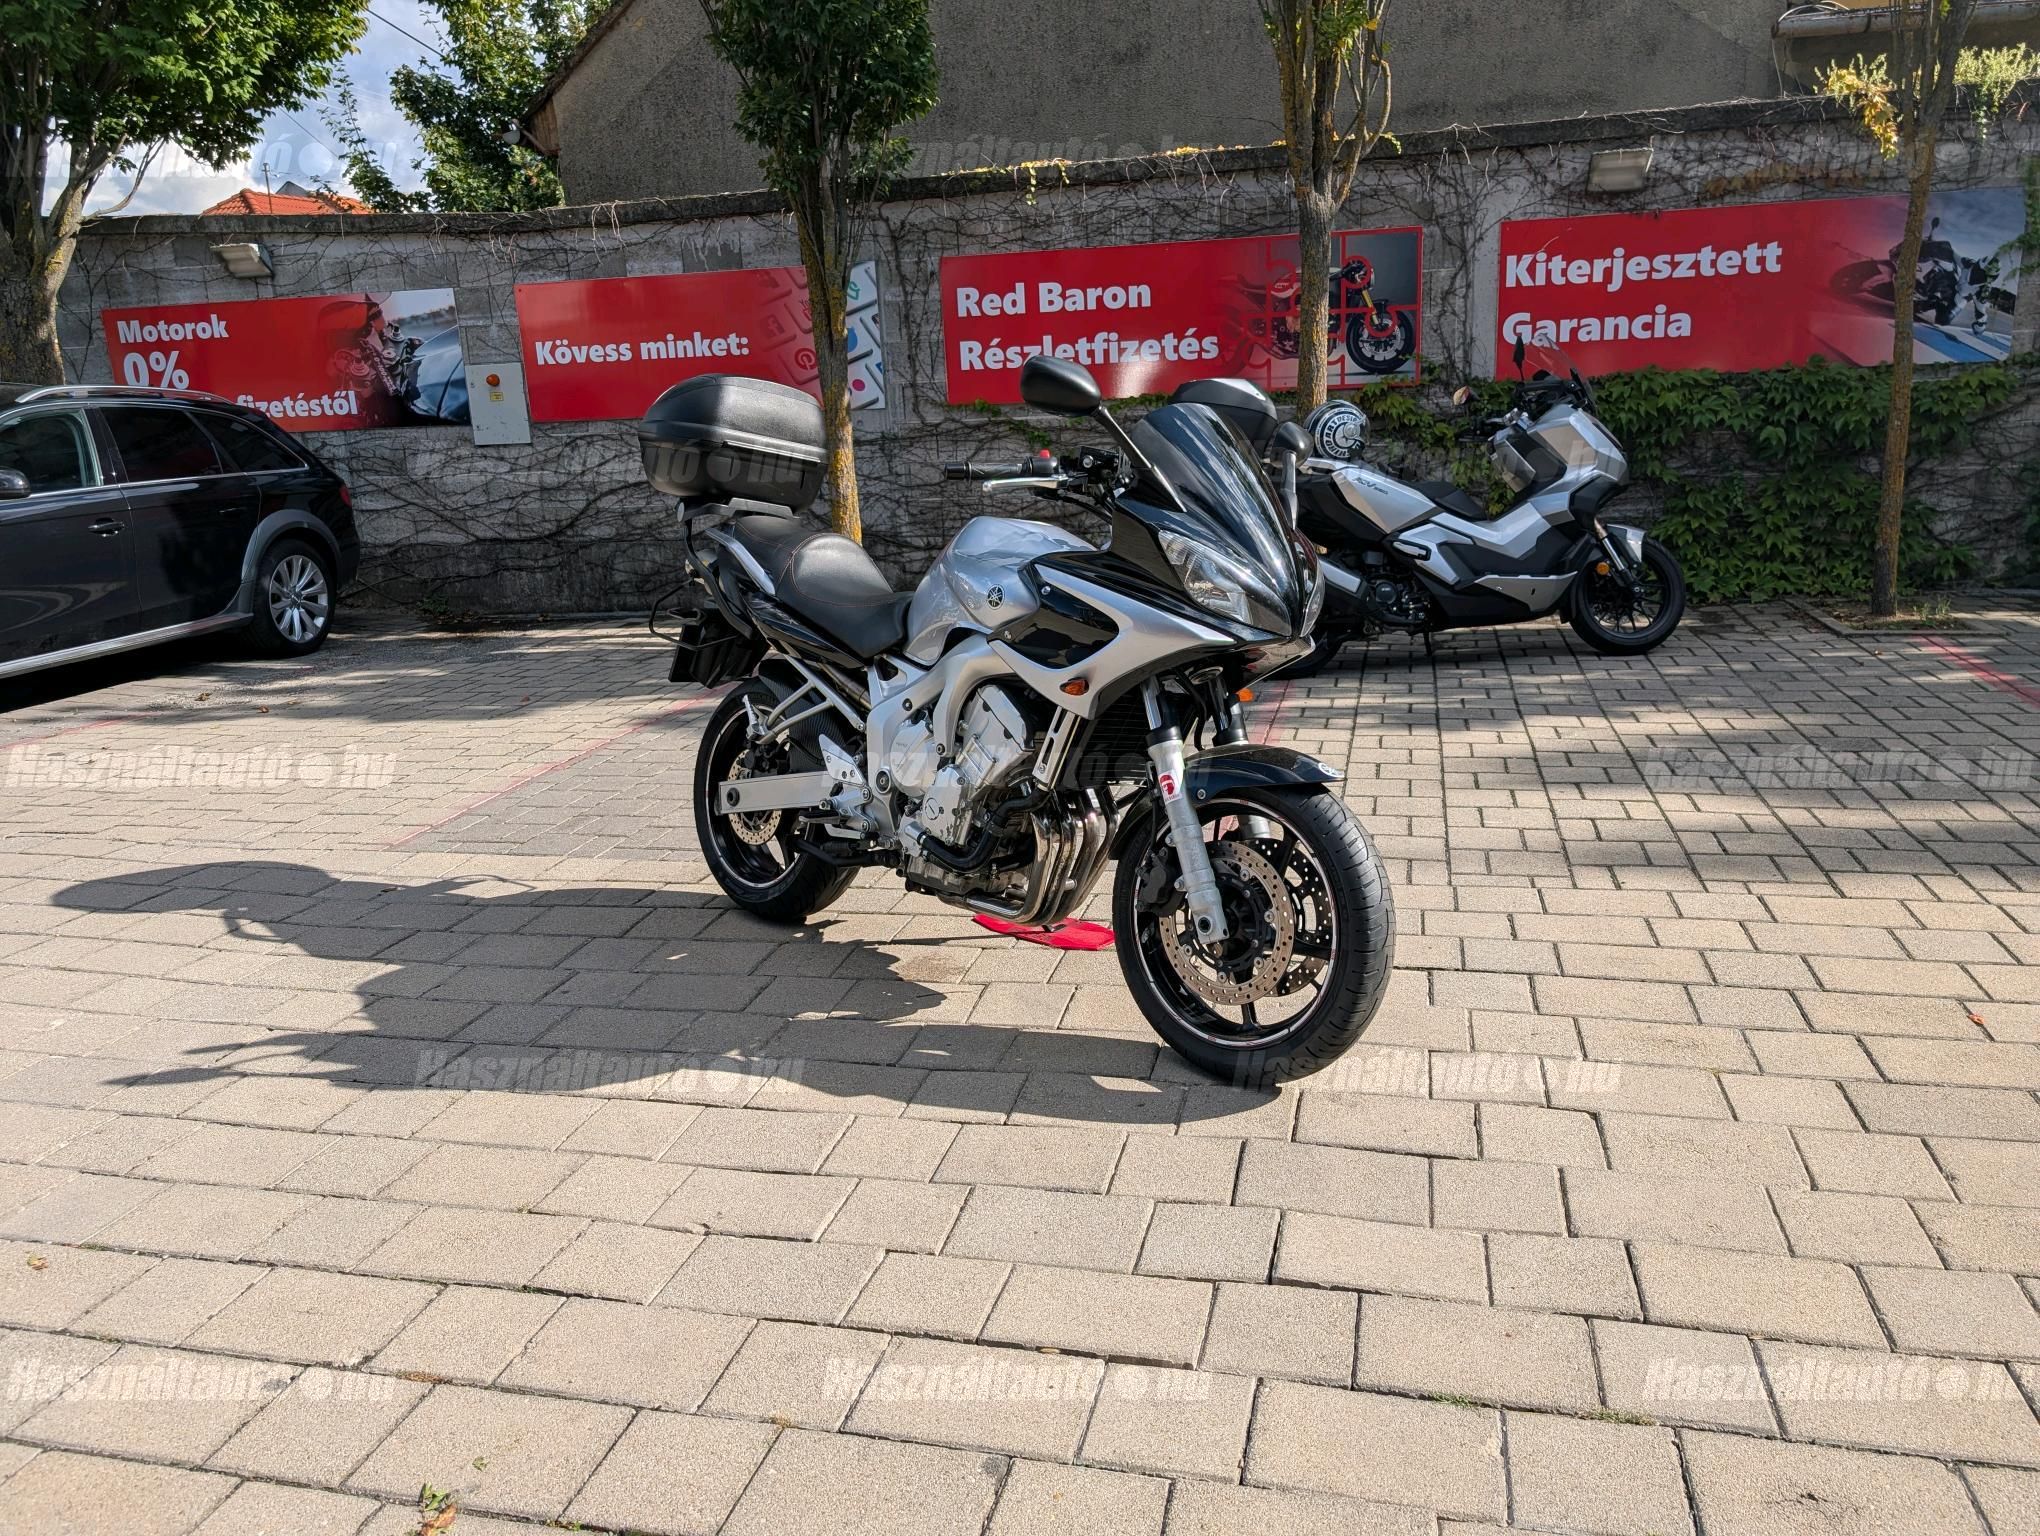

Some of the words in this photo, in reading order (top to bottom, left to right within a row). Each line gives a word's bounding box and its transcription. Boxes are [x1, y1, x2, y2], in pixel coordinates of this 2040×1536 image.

[1505, 241, 1783, 293] Kiterjesztett
[956, 282, 1026, 318] Red
[1038, 281, 1152, 313] Baron
[117, 313, 229, 344] Motorok
[1502, 304, 1692, 351] Garancia
[535, 338, 633, 366] Kövess
[640, 331, 750, 360] minket:
[959, 327, 1220, 371] Részletfizetés
[123, 350, 190, 390] 0%
